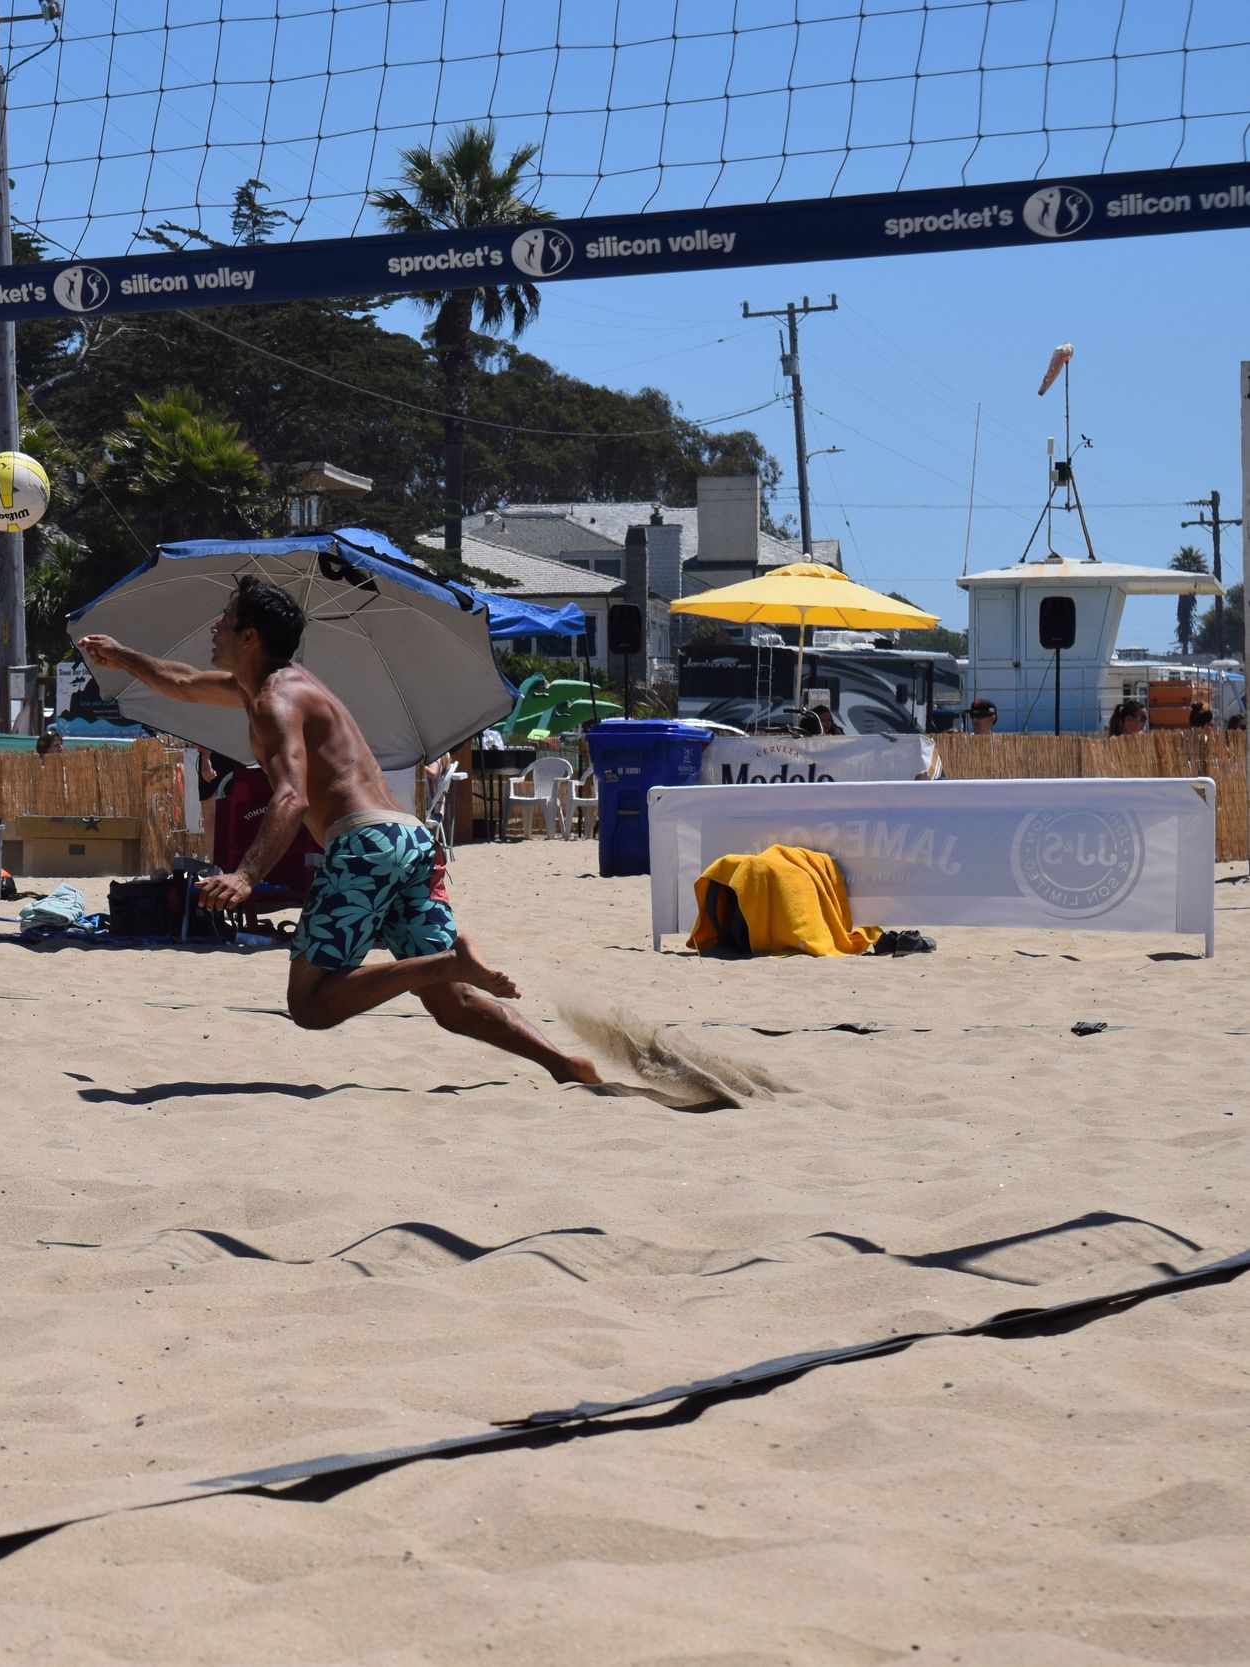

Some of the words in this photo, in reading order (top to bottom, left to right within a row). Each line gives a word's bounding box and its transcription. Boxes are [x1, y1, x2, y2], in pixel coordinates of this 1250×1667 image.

[885, 206, 1013, 238] sprocket's
[1107, 193, 1190, 217] silicon
[388, 246, 503, 276] sprocket's
[586, 236, 661, 259] silicon
[668, 229, 736, 253] volley
[120, 273, 189, 295] silicon
[193, 267, 255, 290] volley
[756, 744, 800, 758] CERVEZA
